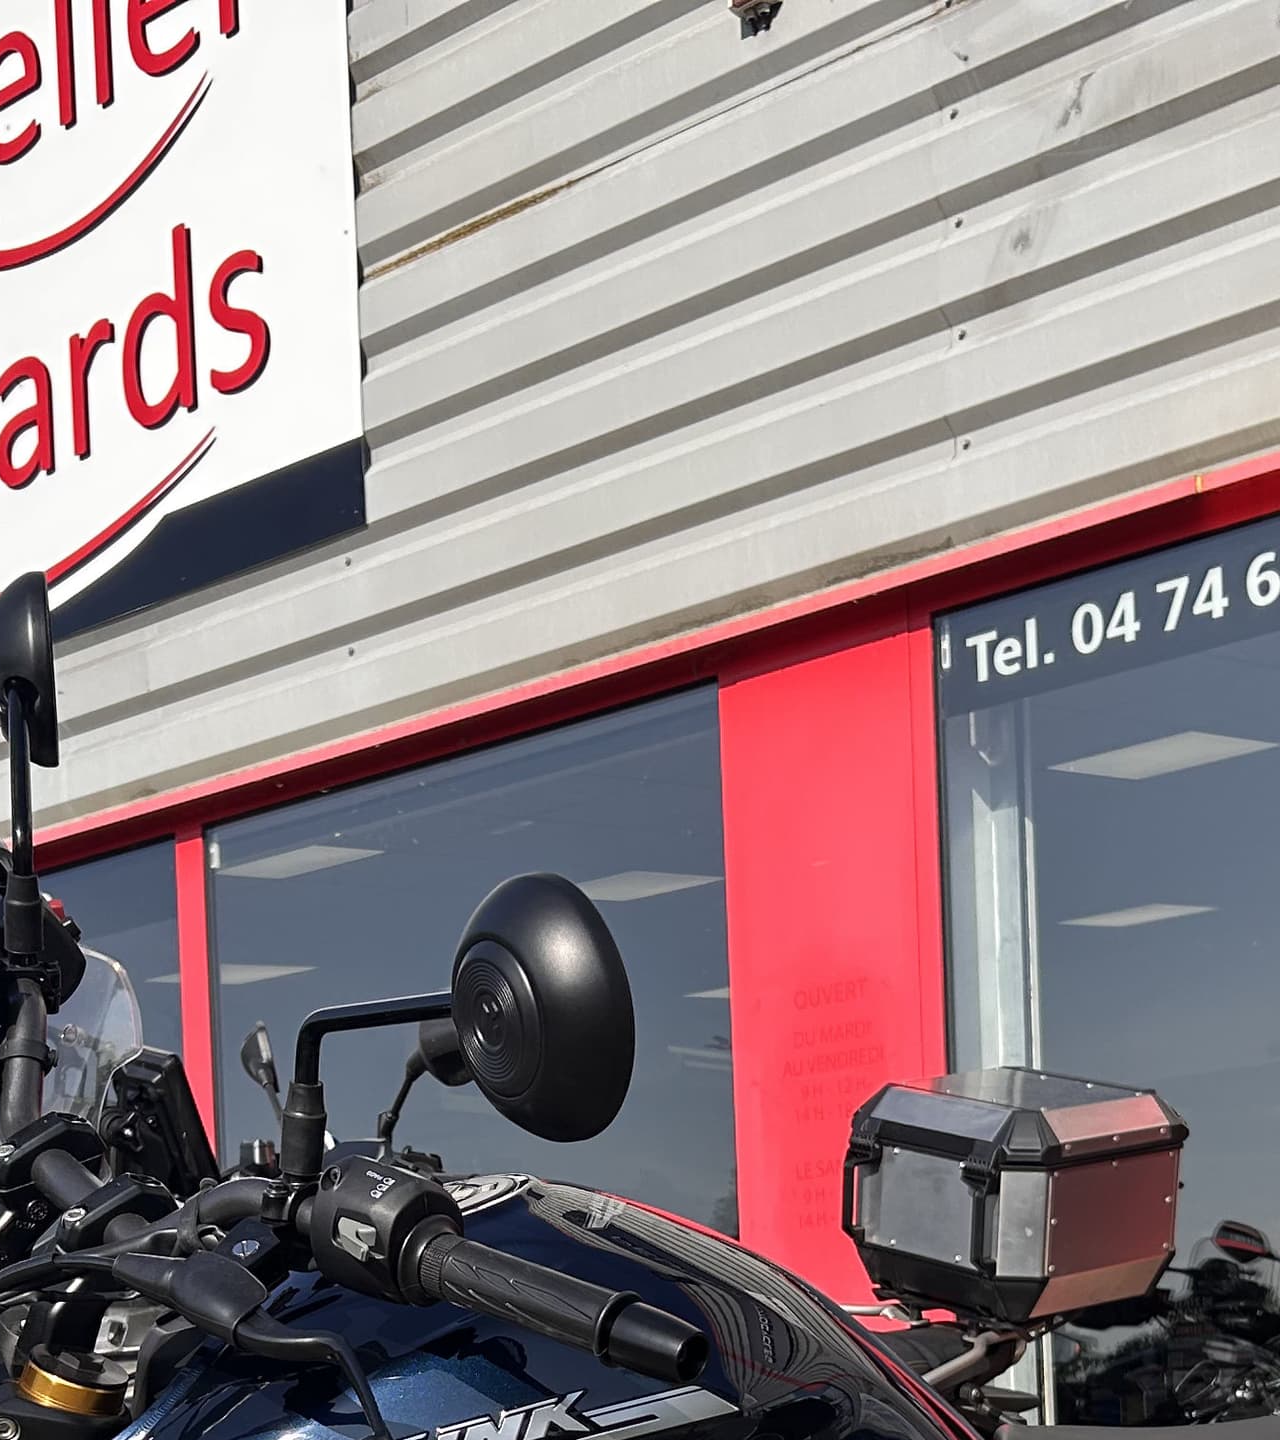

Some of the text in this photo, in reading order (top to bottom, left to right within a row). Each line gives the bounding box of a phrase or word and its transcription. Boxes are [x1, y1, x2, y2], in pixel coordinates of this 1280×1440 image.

[965, 618, 1055, 683] Tel.
[1071, 592, 1141, 655] 04
[1156, 567, 1228, 632] 74
[793, 976, 870, 1011] OUVERT
